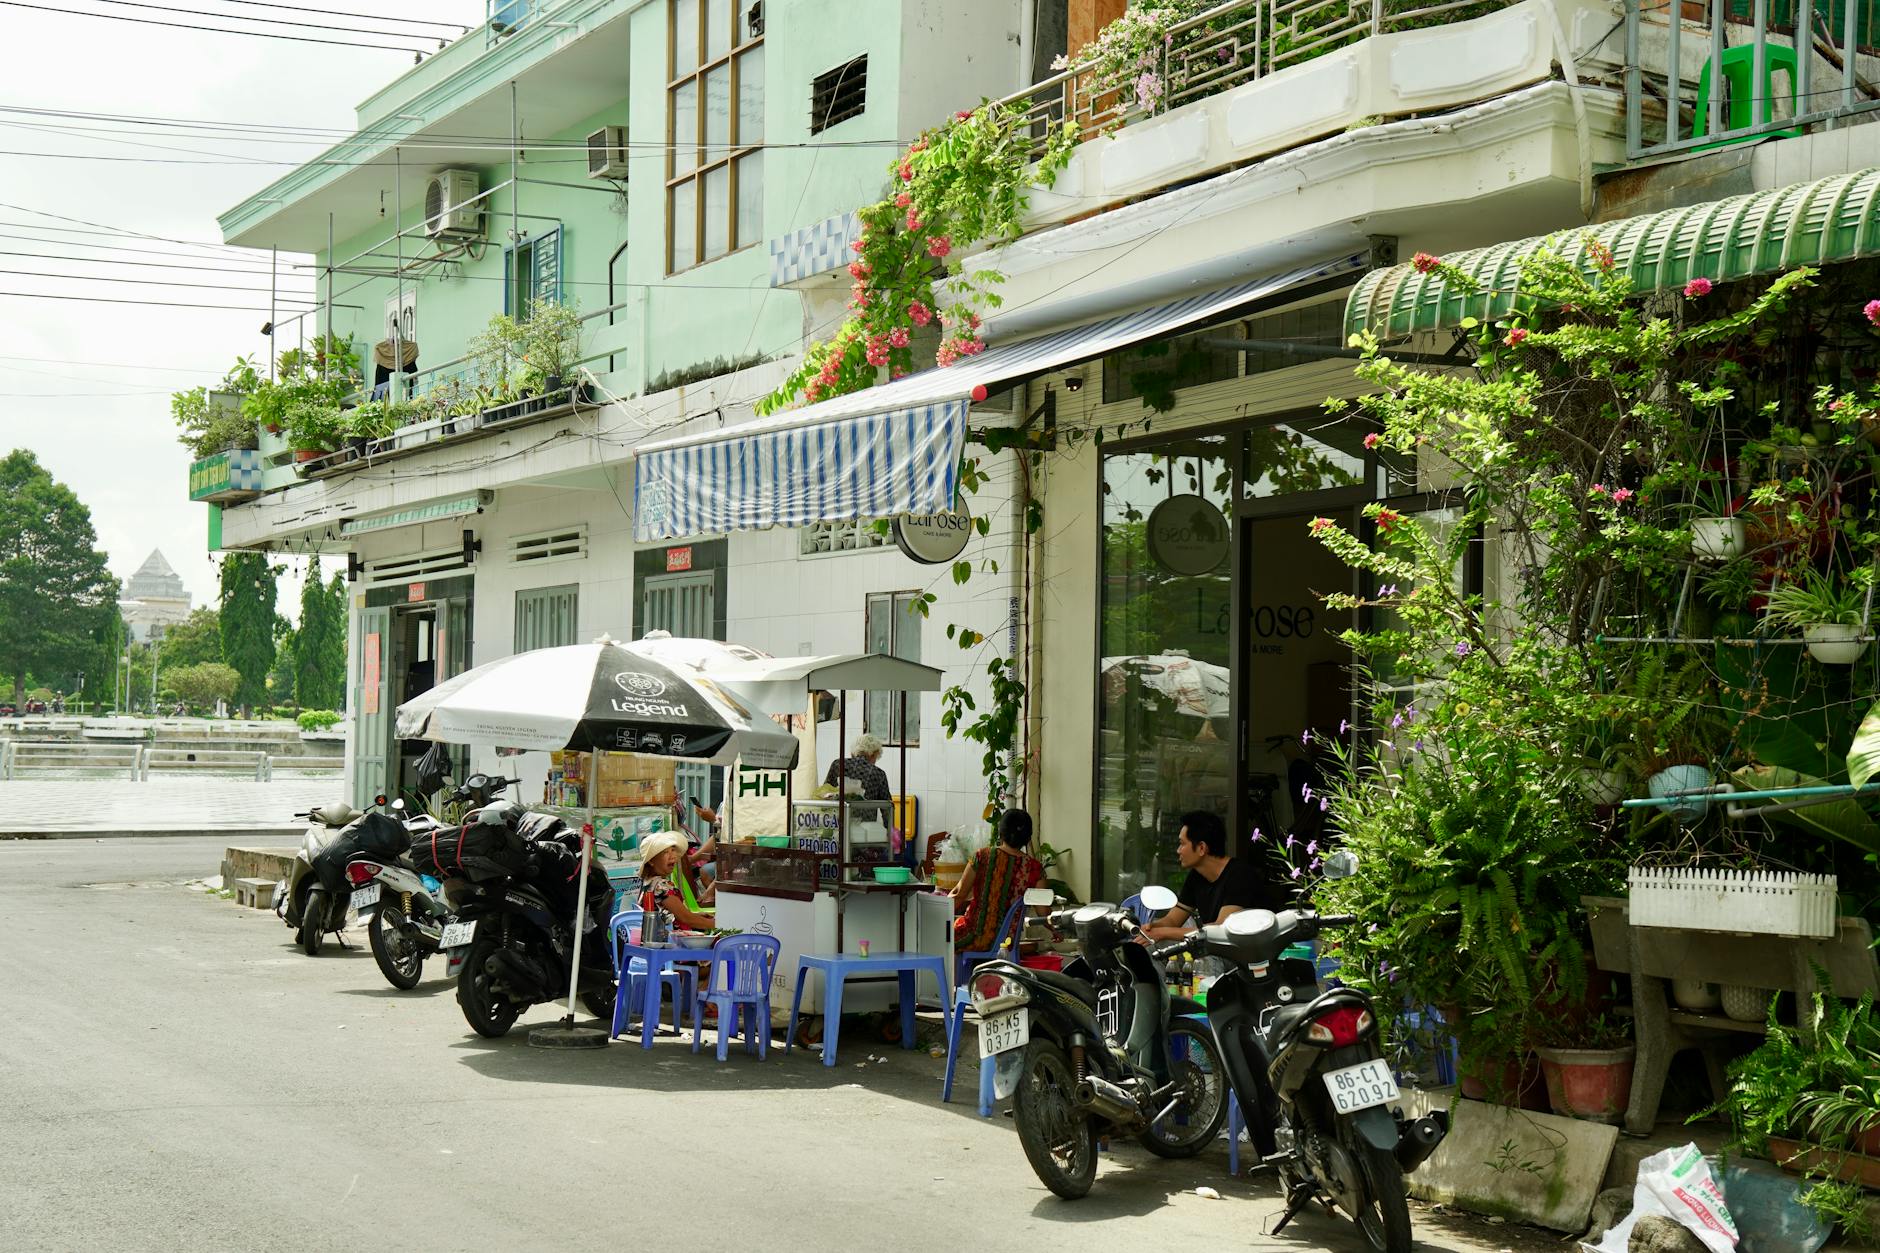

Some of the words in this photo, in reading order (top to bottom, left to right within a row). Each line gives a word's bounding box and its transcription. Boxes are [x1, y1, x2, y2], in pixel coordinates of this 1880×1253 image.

[1197, 586, 1315, 639] Laose
[611, 698, 688, 716] Legend
[797, 811, 820, 829] CƠM
[986, 1013, 1020, 1036] 86-K5
[986, 1029, 1021, 1053] 0377
[1335, 1065, 1380, 1090] 86-C1
[1336, 1081, 1395, 1109] 620.92
